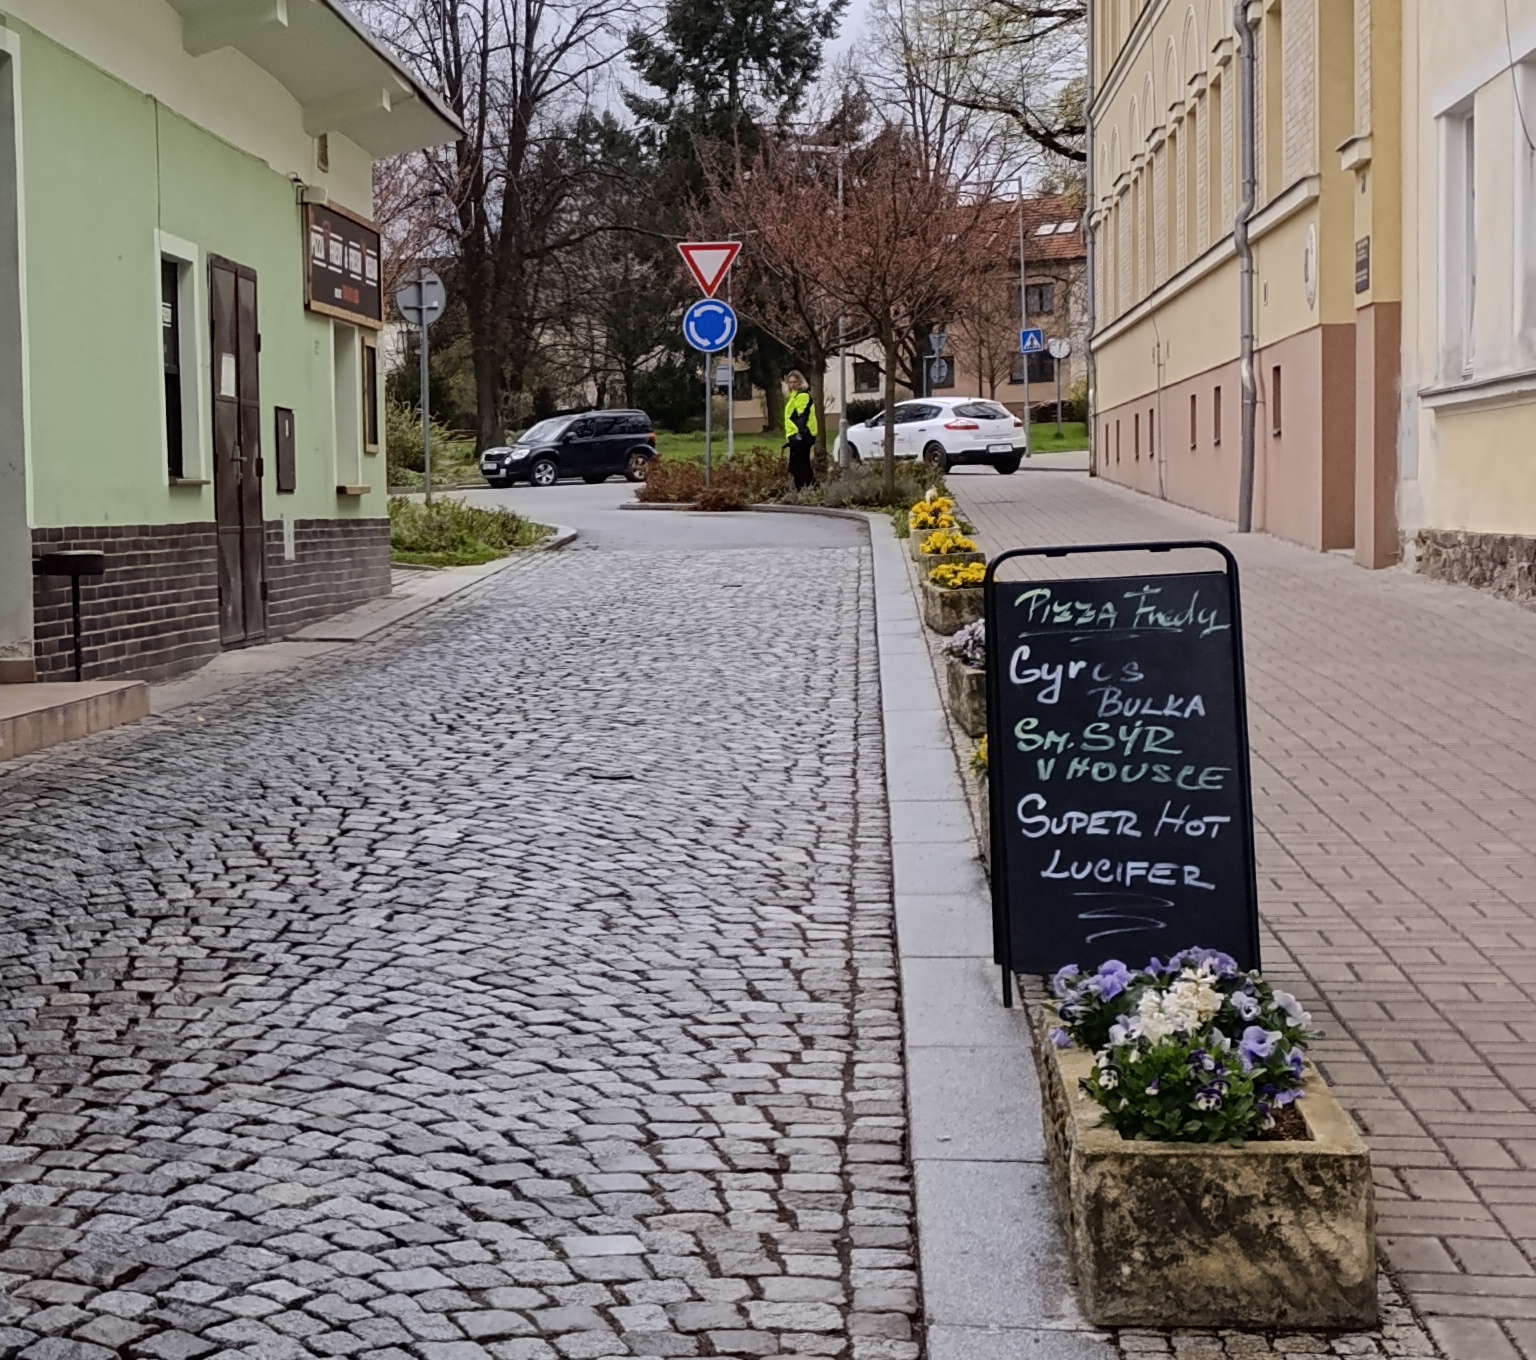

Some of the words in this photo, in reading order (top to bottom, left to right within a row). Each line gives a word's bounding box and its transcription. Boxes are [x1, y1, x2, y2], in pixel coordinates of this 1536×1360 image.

[1014, 588, 1118, 628] PIZZA
[1087, 685, 1206, 718] BULKA
[1017, 793, 1142, 838] SUPER
[1040, 849, 1216, 890] LUCIFER
